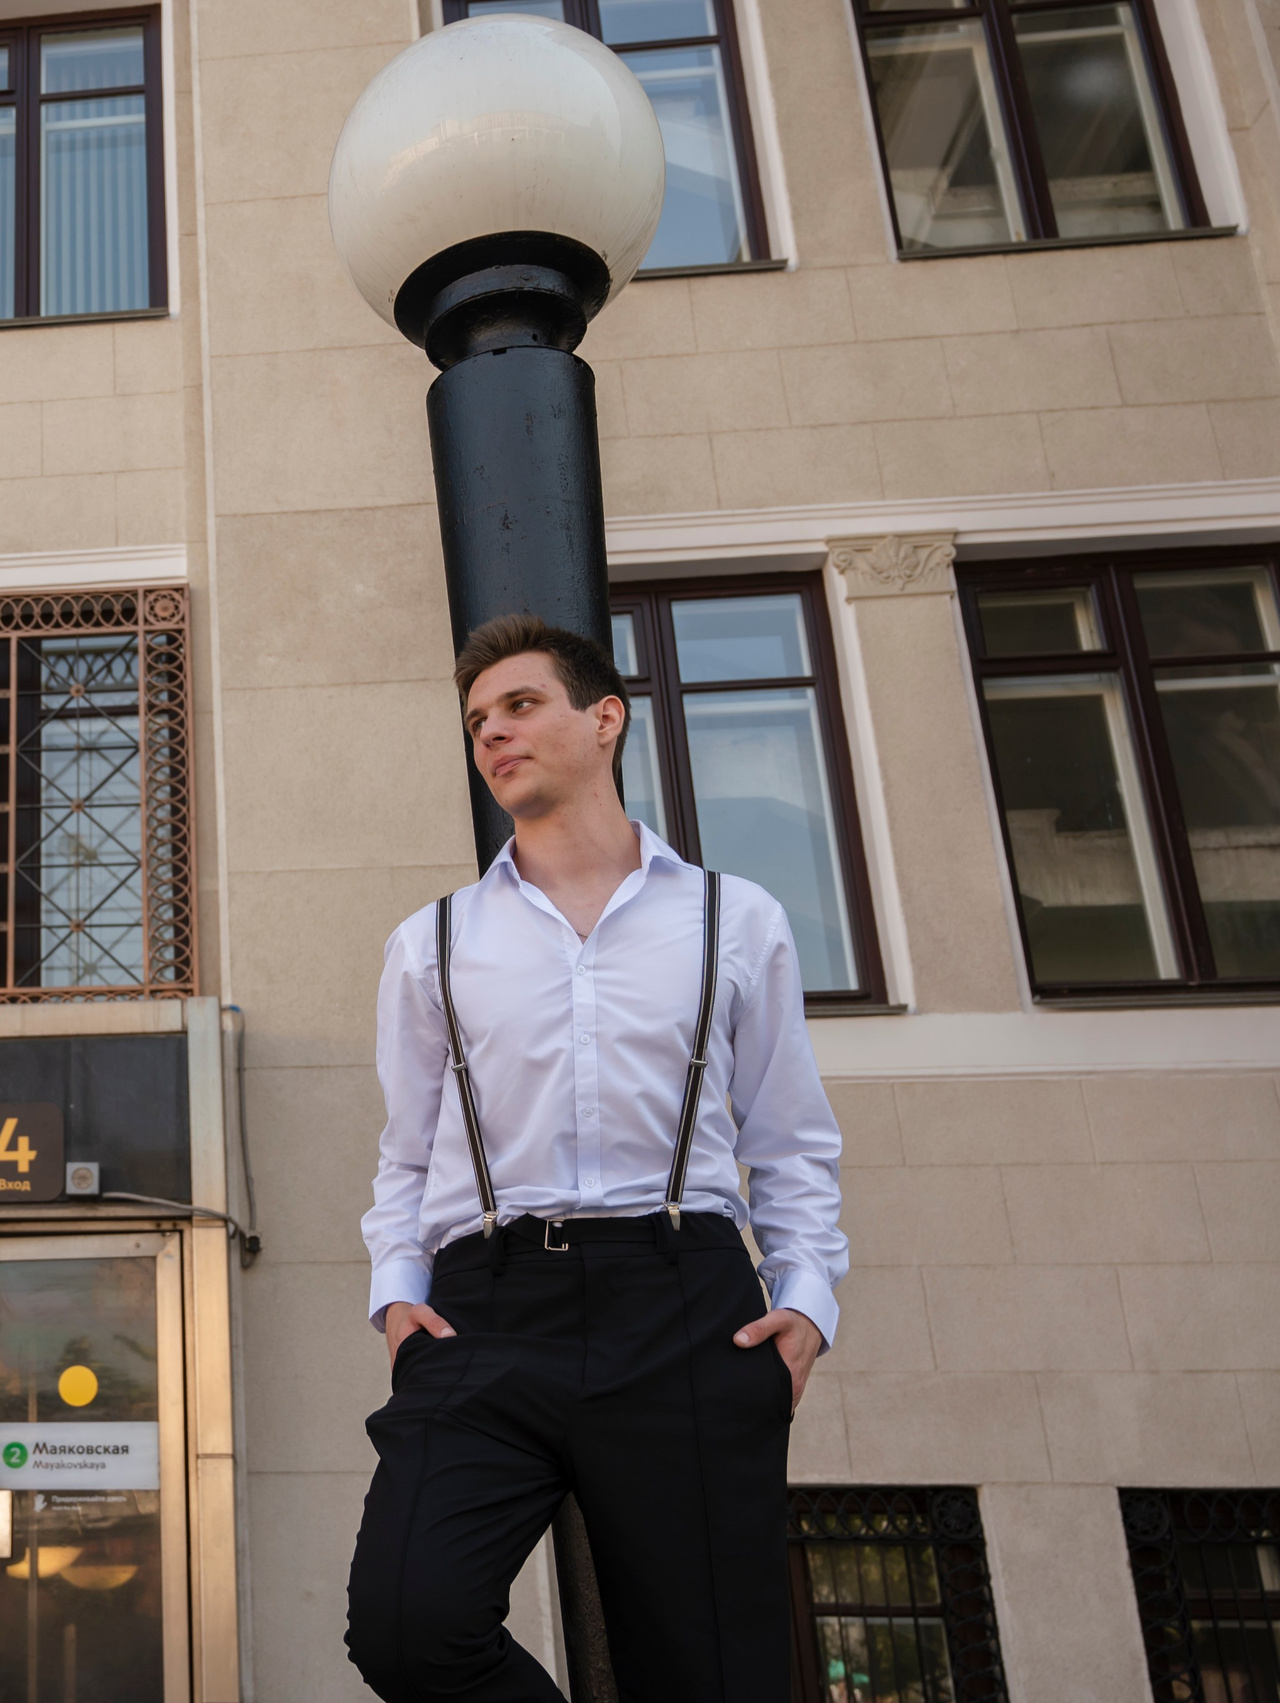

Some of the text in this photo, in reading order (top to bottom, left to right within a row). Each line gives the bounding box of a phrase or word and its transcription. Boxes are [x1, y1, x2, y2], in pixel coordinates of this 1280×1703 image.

[9, 1447, 21, 1463] 2
[32, 1441, 130, 1455] Маяковская
[32, 1460, 107, 1471] Mayakovskaya
